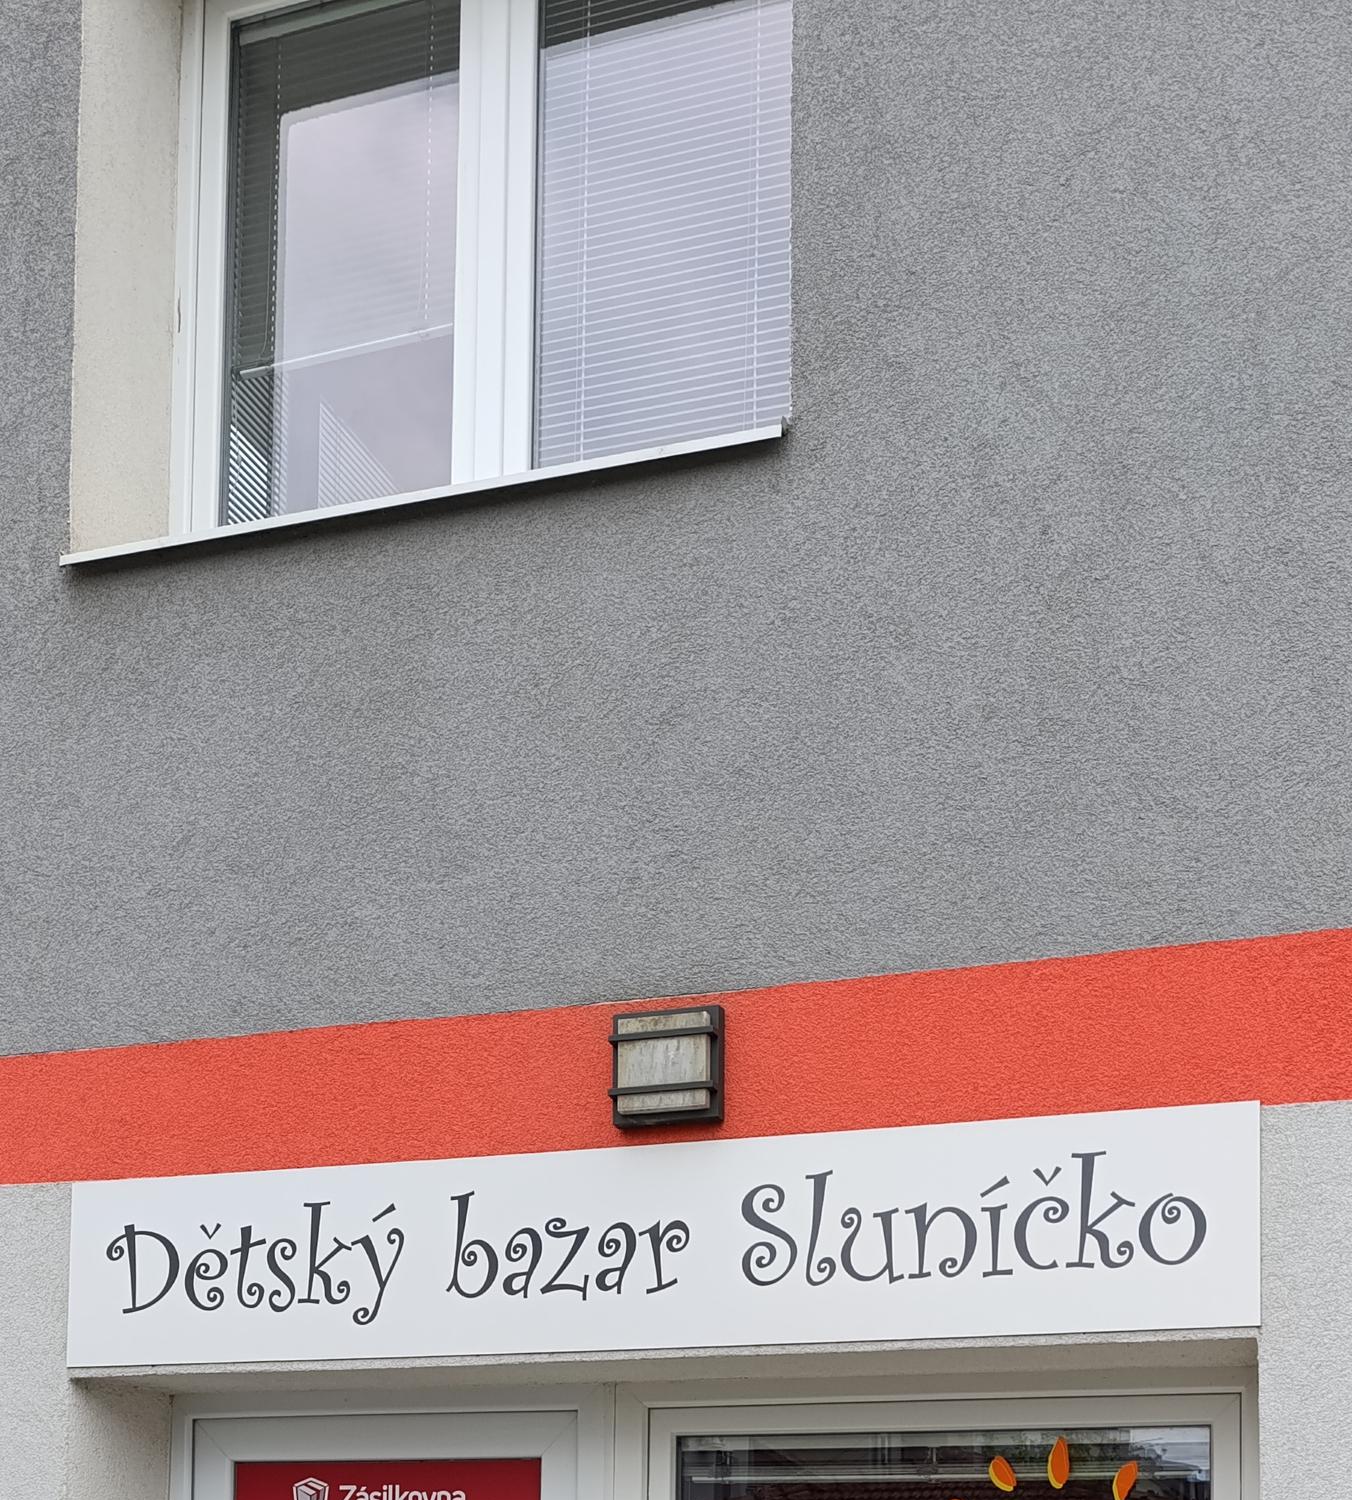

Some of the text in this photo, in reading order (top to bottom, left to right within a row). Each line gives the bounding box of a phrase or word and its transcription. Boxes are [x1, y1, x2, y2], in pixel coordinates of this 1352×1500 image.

[106, 1150, 1207, 1326] Dětský bazar Sluníčko
